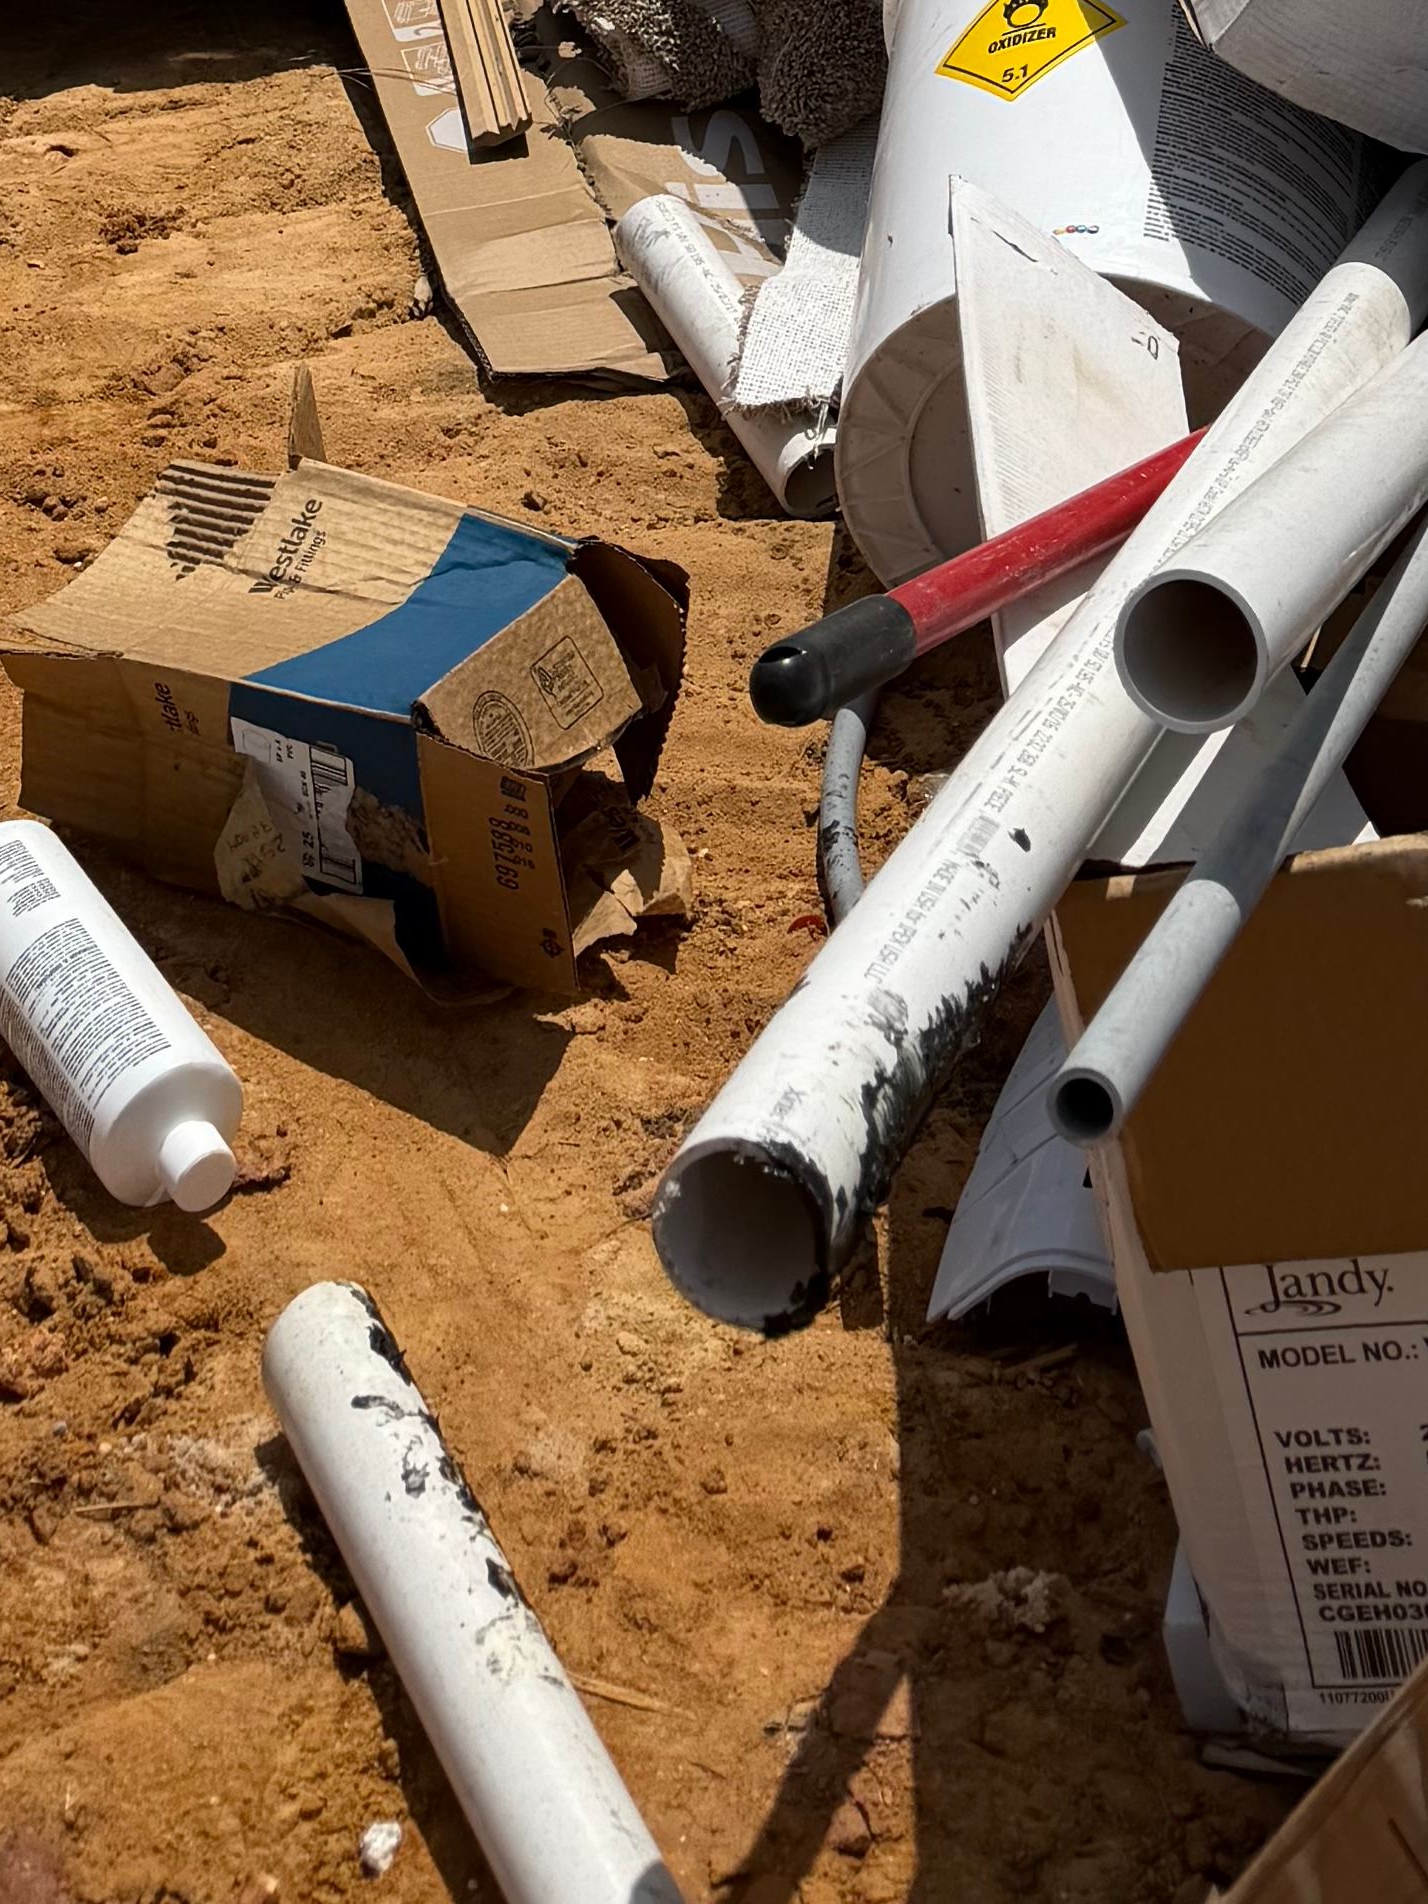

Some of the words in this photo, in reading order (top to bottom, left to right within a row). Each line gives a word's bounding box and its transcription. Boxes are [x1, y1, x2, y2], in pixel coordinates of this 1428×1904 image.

[985, 23, 1058, 55] OXIDIZER
[998, 62, 1031, 84] 5.1
[247, 491, 324, 600] Westlake
[1258, 1344, 1356, 1368] MODEL
[1362, 1340, 1419, 1362] NO.:
[1274, 1428, 1370, 1448] VOLTS:
[1284, 1453, 1381, 1474] HERTZ:
[1290, 1479, 1386, 1499] PHASE:
[1295, 1507, 1357, 1526] THP:
[1302, 1530, 1412, 1551] SPEEDS:
[1306, 1557, 1371, 1575] WEF:
[1313, 1581, 1390, 1600] SERIAL
